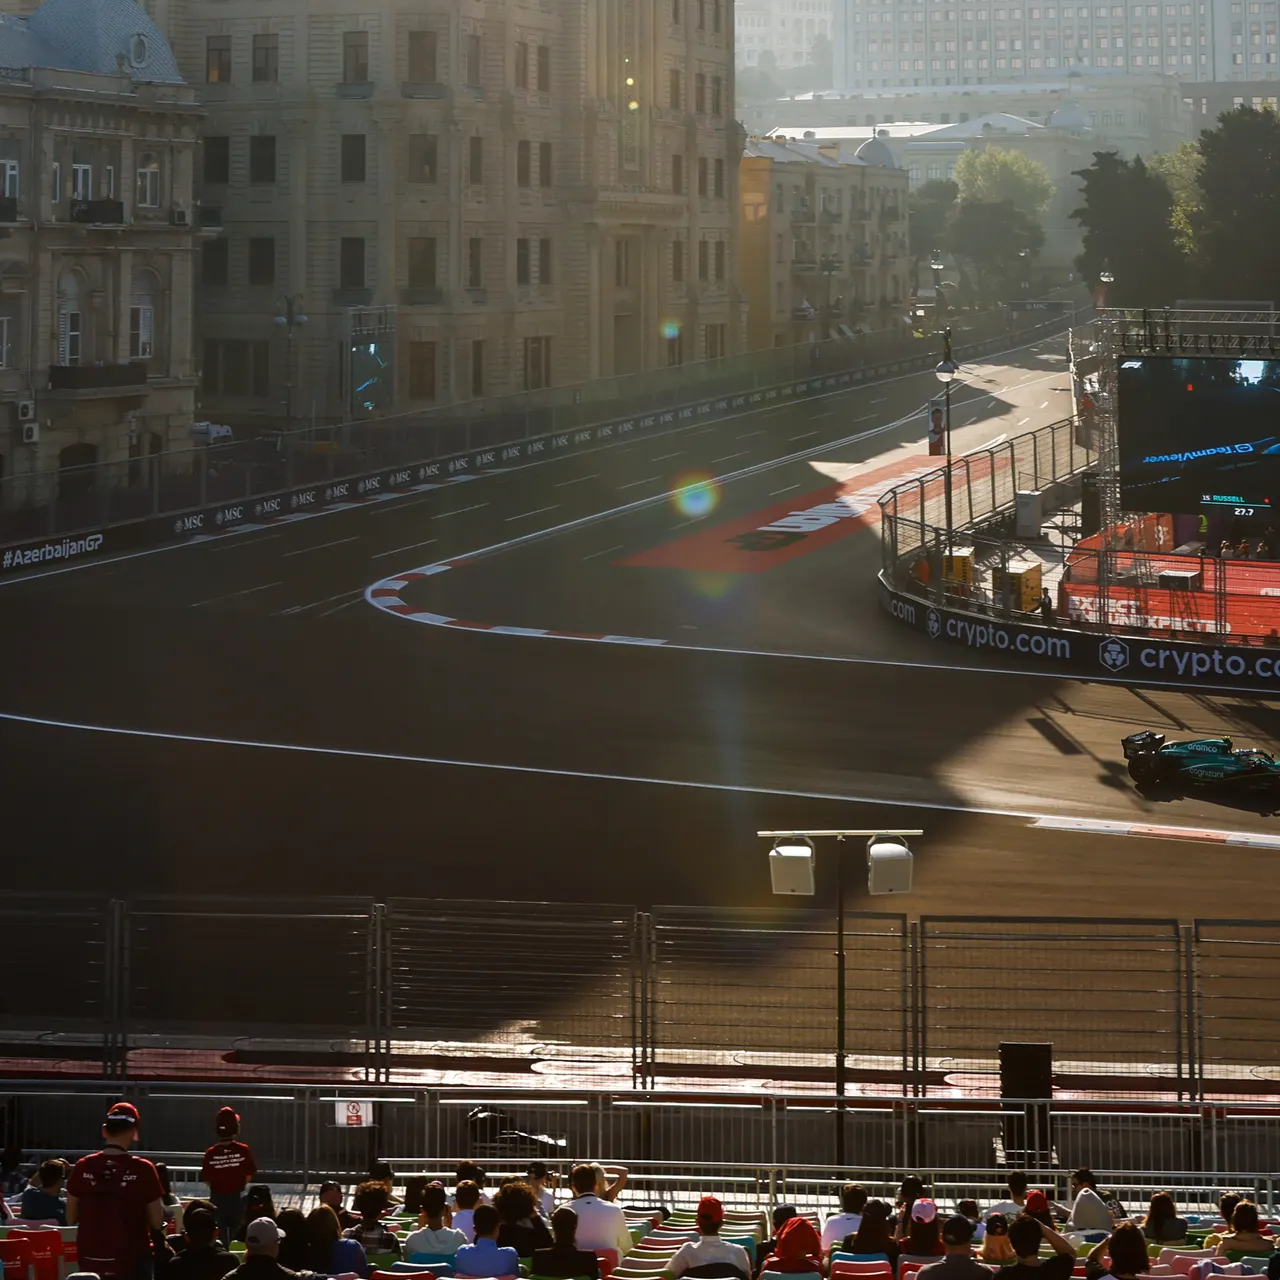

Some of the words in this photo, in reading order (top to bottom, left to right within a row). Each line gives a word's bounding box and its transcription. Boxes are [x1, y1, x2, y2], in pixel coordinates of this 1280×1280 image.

[396, 470, 411, 485] MSC
[425, 464, 440, 477] MSC
[333, 483, 349, 498] MSC
[365, 476, 381, 491] MSC
[263, 498, 281, 514] MSC
[298, 491, 316, 506] MSC
[1212, 495, 1246, 503] RUSSELL
[224, 506, 244, 522] MSC
[1234, 507, 1255, 516] 27.7
[183, 514, 204, 530] MSC
[946, 617, 1070, 659] crypto.com
[1187, 743, 1218, 753] aramco
[1189, 767, 1224, 779] cognizant
